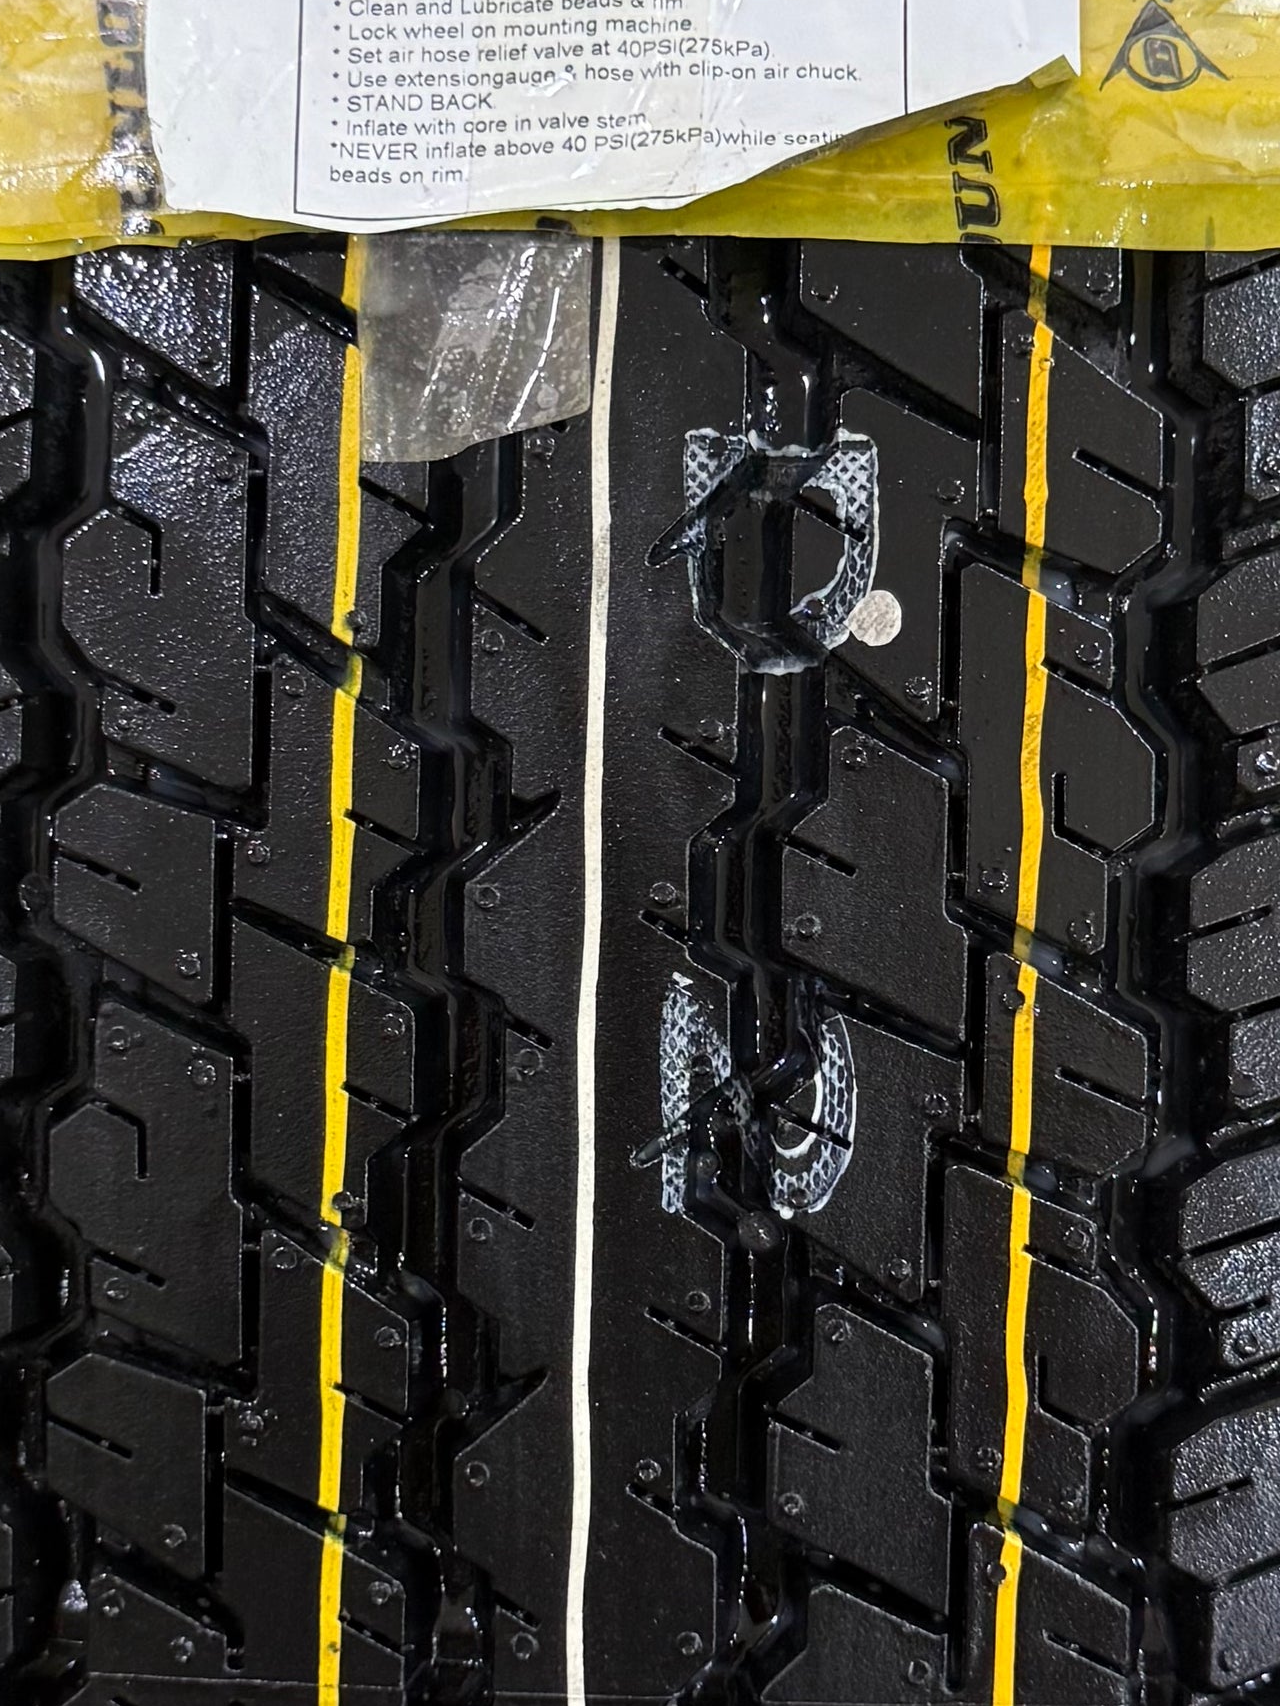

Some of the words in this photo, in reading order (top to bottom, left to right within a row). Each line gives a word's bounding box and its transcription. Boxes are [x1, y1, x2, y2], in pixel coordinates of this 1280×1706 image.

[349, 0, 408, 16] Clean
[349, 22, 397, 40] Lock
[403, 21, 464, 39] wheel
[472, 25, 496, 39] on
[504, 18, 597, 38] mounting
[348, 47, 382, 64] Set
[388, 46, 413, 63] air
[422, 44, 470, 63] hose
[478, 43, 527, 61] relief
[533, 41, 584, 60] valve
[591, 41, 611, 56] at
[347, 70, 388, 88] Use
[585, 65, 634, 82] hose
[642, 61, 681, 79] with
[689, 61, 756, 80] clip-on
[764, 64, 789, 80] air
[347, 94, 423, 113] STAND
[346, 118, 408, 137] Inflate
[414, 117, 455, 135] with
[464, 118, 508, 134] core
[515, 115, 531, 132] in
[538, 112, 589, 131] valve
[426, 139, 487, 159] inflate
[494, 136, 554, 156] above
[561, 135, 587, 152] 40
[330, 166, 392, 184] beads
[400, 169, 423, 184] on
